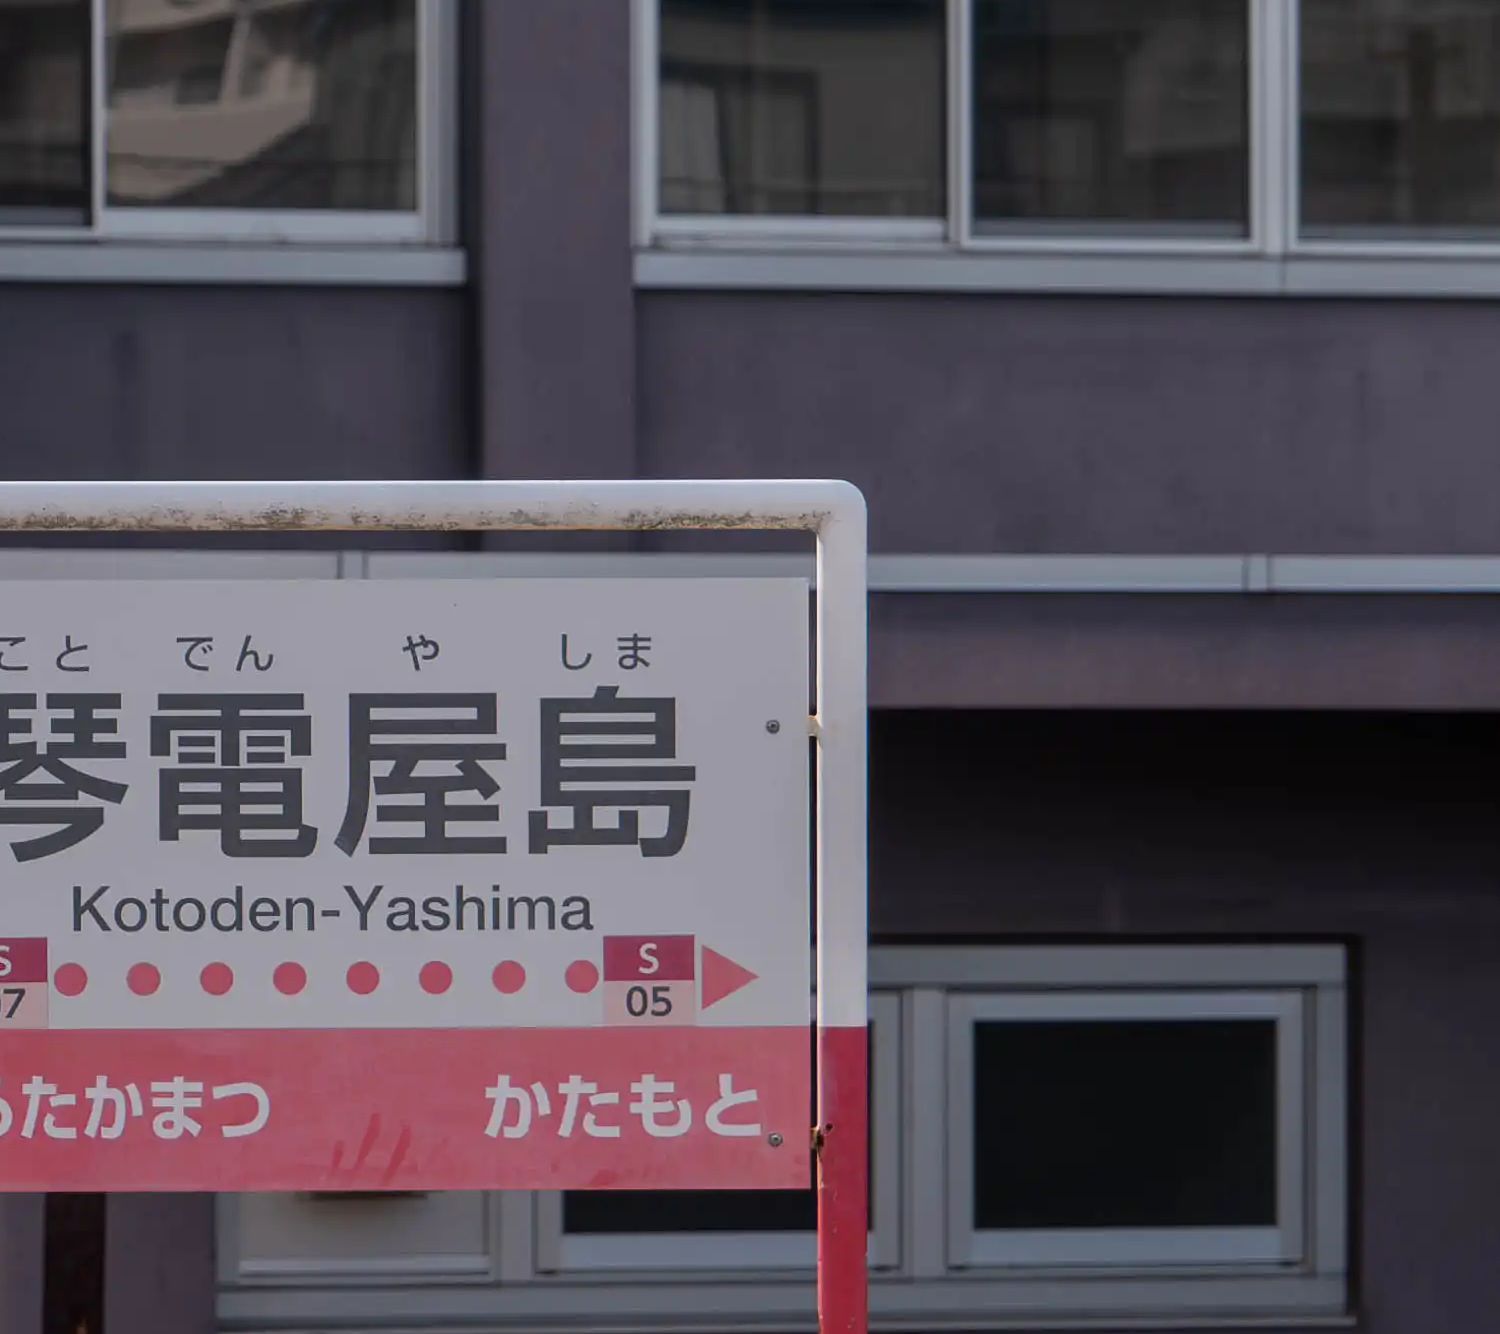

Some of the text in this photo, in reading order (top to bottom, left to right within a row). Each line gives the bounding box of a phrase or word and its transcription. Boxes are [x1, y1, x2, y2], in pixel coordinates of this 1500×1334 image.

[72, 884, 595, 933] Kotoden-Yashima
[638, 942, 660, 975] S
[626, 985, 673, 1017] 05
[483, 1073, 762, 1139] かたもと
